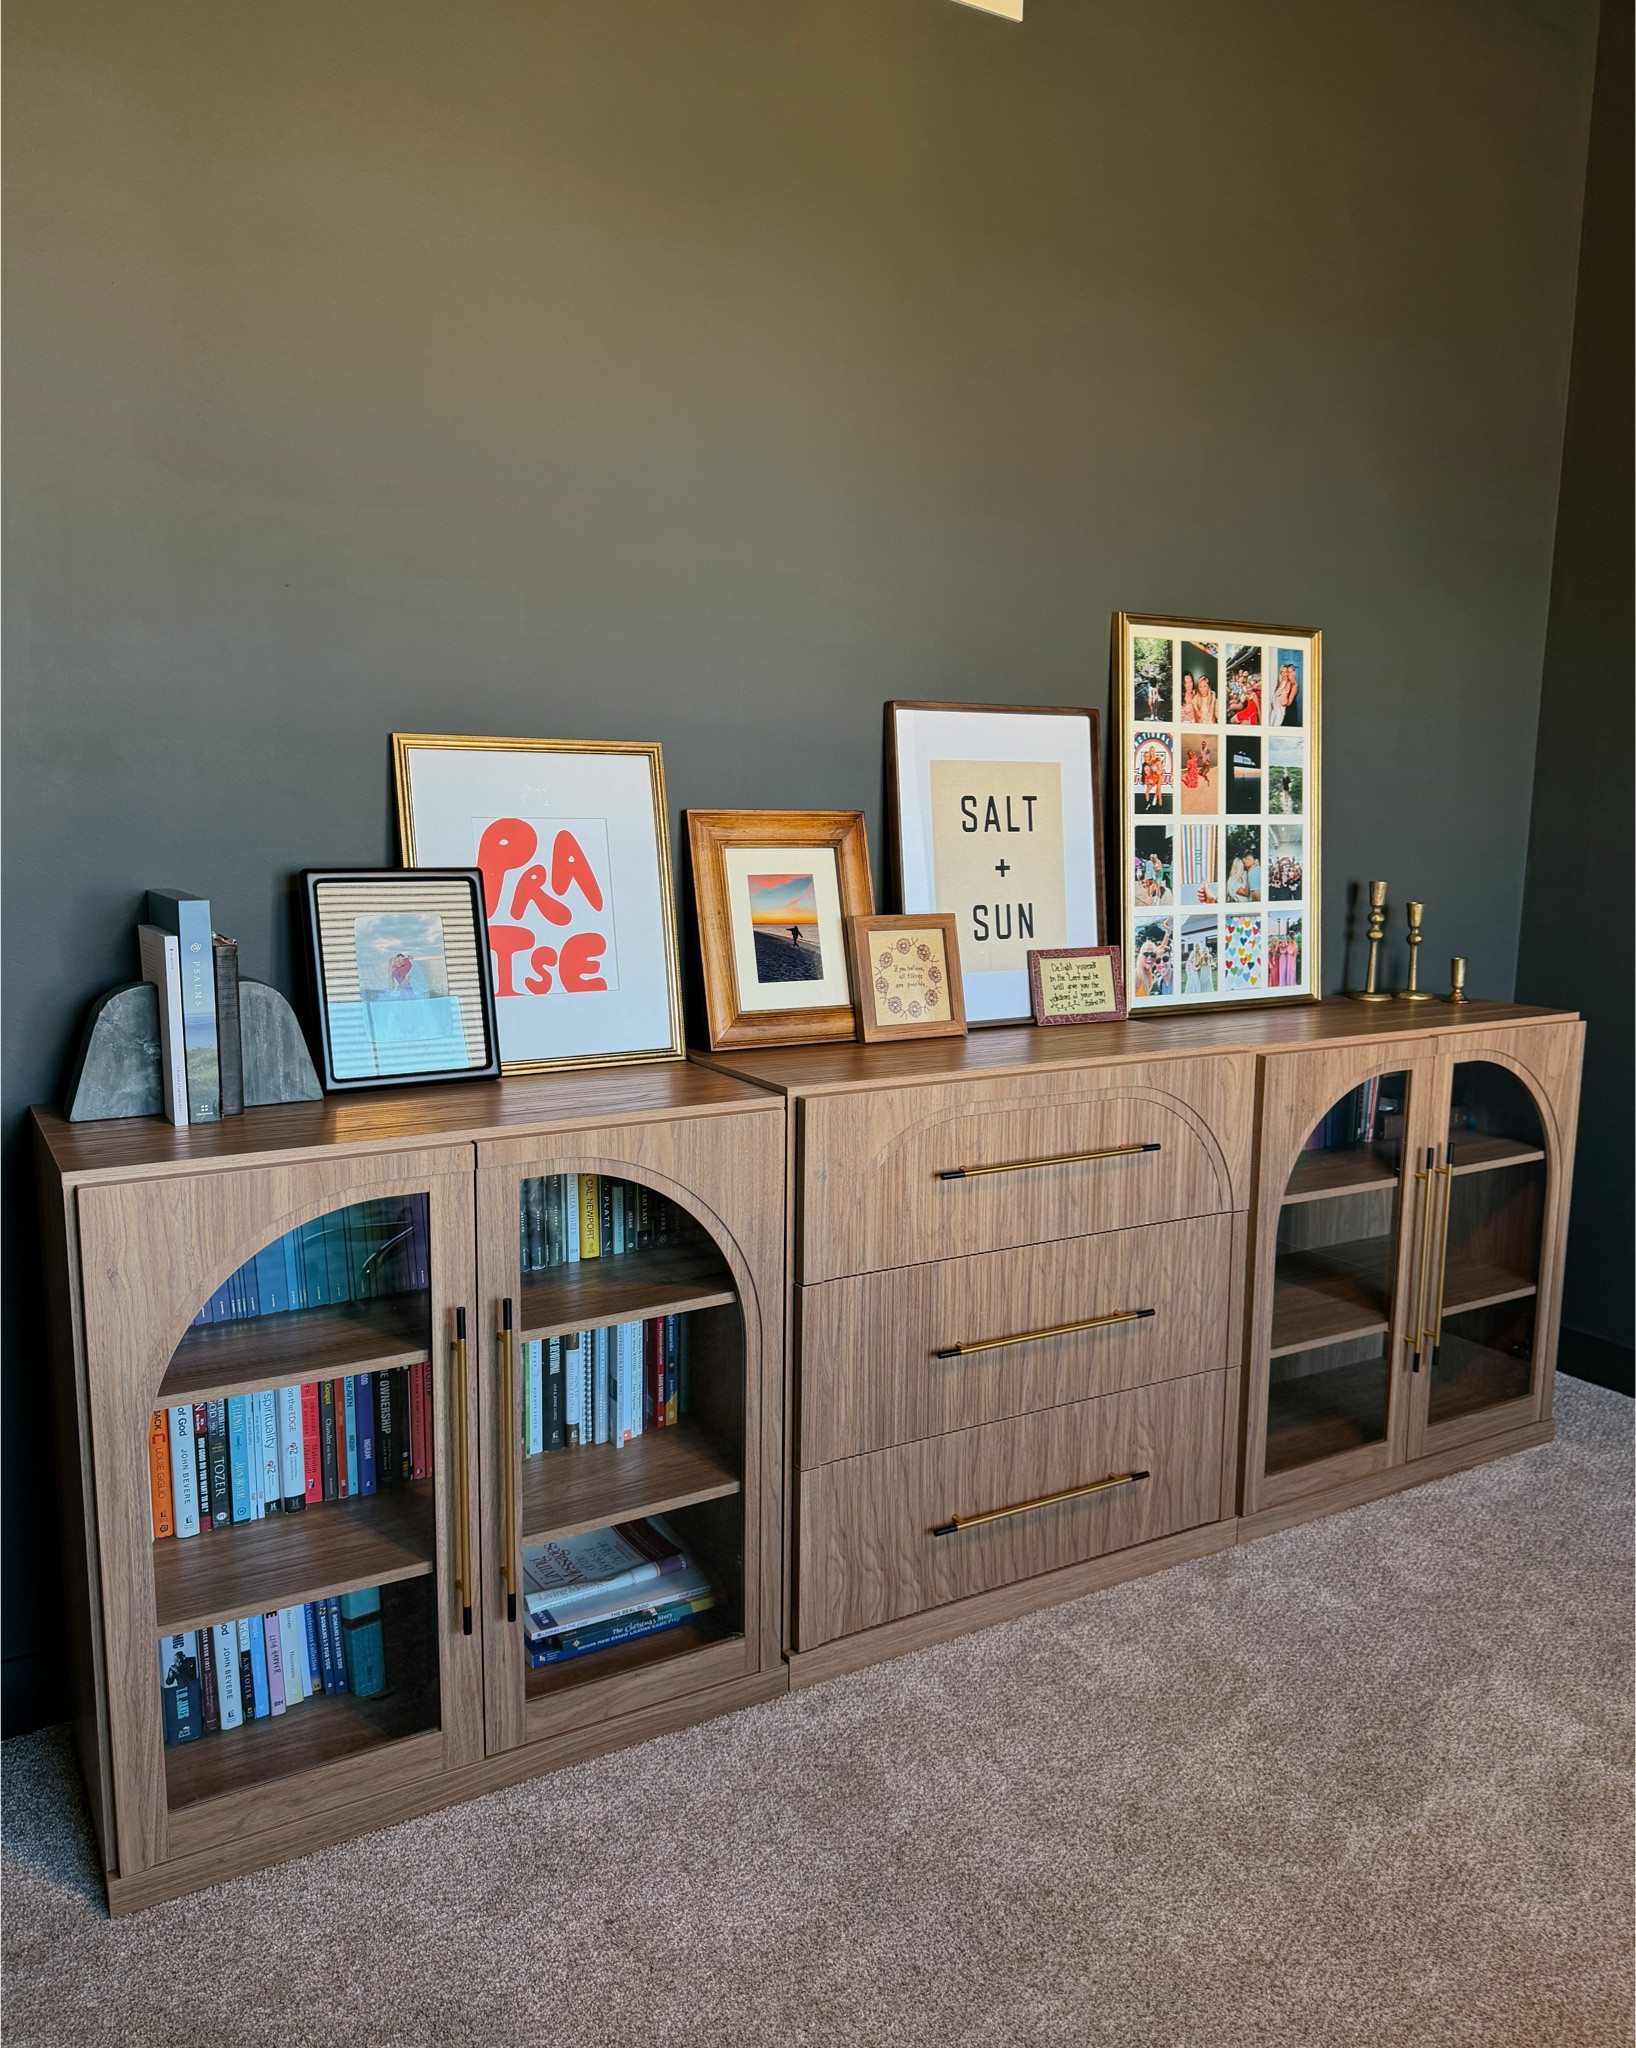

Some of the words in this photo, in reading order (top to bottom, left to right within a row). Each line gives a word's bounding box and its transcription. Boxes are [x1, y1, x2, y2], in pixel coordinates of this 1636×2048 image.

[961, 795, 1037, 832] SALT
[995, 859, 1010, 877] +
[973, 903, 1034, 941] SUN
[193, 961, 203, 1007] PSALMS
[586, 1179, 594, 1196] CAL
[586, 1199, 595, 1240] NEWPORT
[287, 1388, 293, 1398] on
[324, 1383, 332, 1404] Gospel
[178, 1407, 185, 1416] of
[288, 1399, 296, 1411] the
[380, 1380, 392, 1435] OWNERSHIP
[178, 1418, 188, 1436] God
[263, 1393, 276, 1449] spirituality
[289, 1412, 297, 1432] EDGE
[325, 1418, 333, 1444] Chandler
[156, 1448, 164, 1470] LOUIE
[181, 1449, 189, 1470] JOHN
[363, 1439, 372, 1460] INGRAM
[156, 1473, 166, 1499] GIGLIO
[214, 1457, 226, 1497] TOZER
[183, 1473, 191, 1504] BEVERE
[530, 1555, 564, 1585] Living
[544, 1542, 587, 1583] Messages
[538, 1589, 568, 1600] Living
[637, 1603, 650, 1611] GOD
[306, 1610, 316, 1642] Confessions
[332, 1614, 340, 1636] ROMANS
[612, 1627, 624, 1635] The
[624, 1618, 657, 1633] Christmas
[657, 1613, 673, 1621] Story
[239, 1622, 247, 1646] GOD
[244, 1674, 252, 1700] TOZER
[271, 1651, 281, 1674] HARPER
[176, 1687, 188, 1700] T.D.
[225, 1670, 233, 1700] BEVERE
[177, 1701, 190, 1719] JAKES
